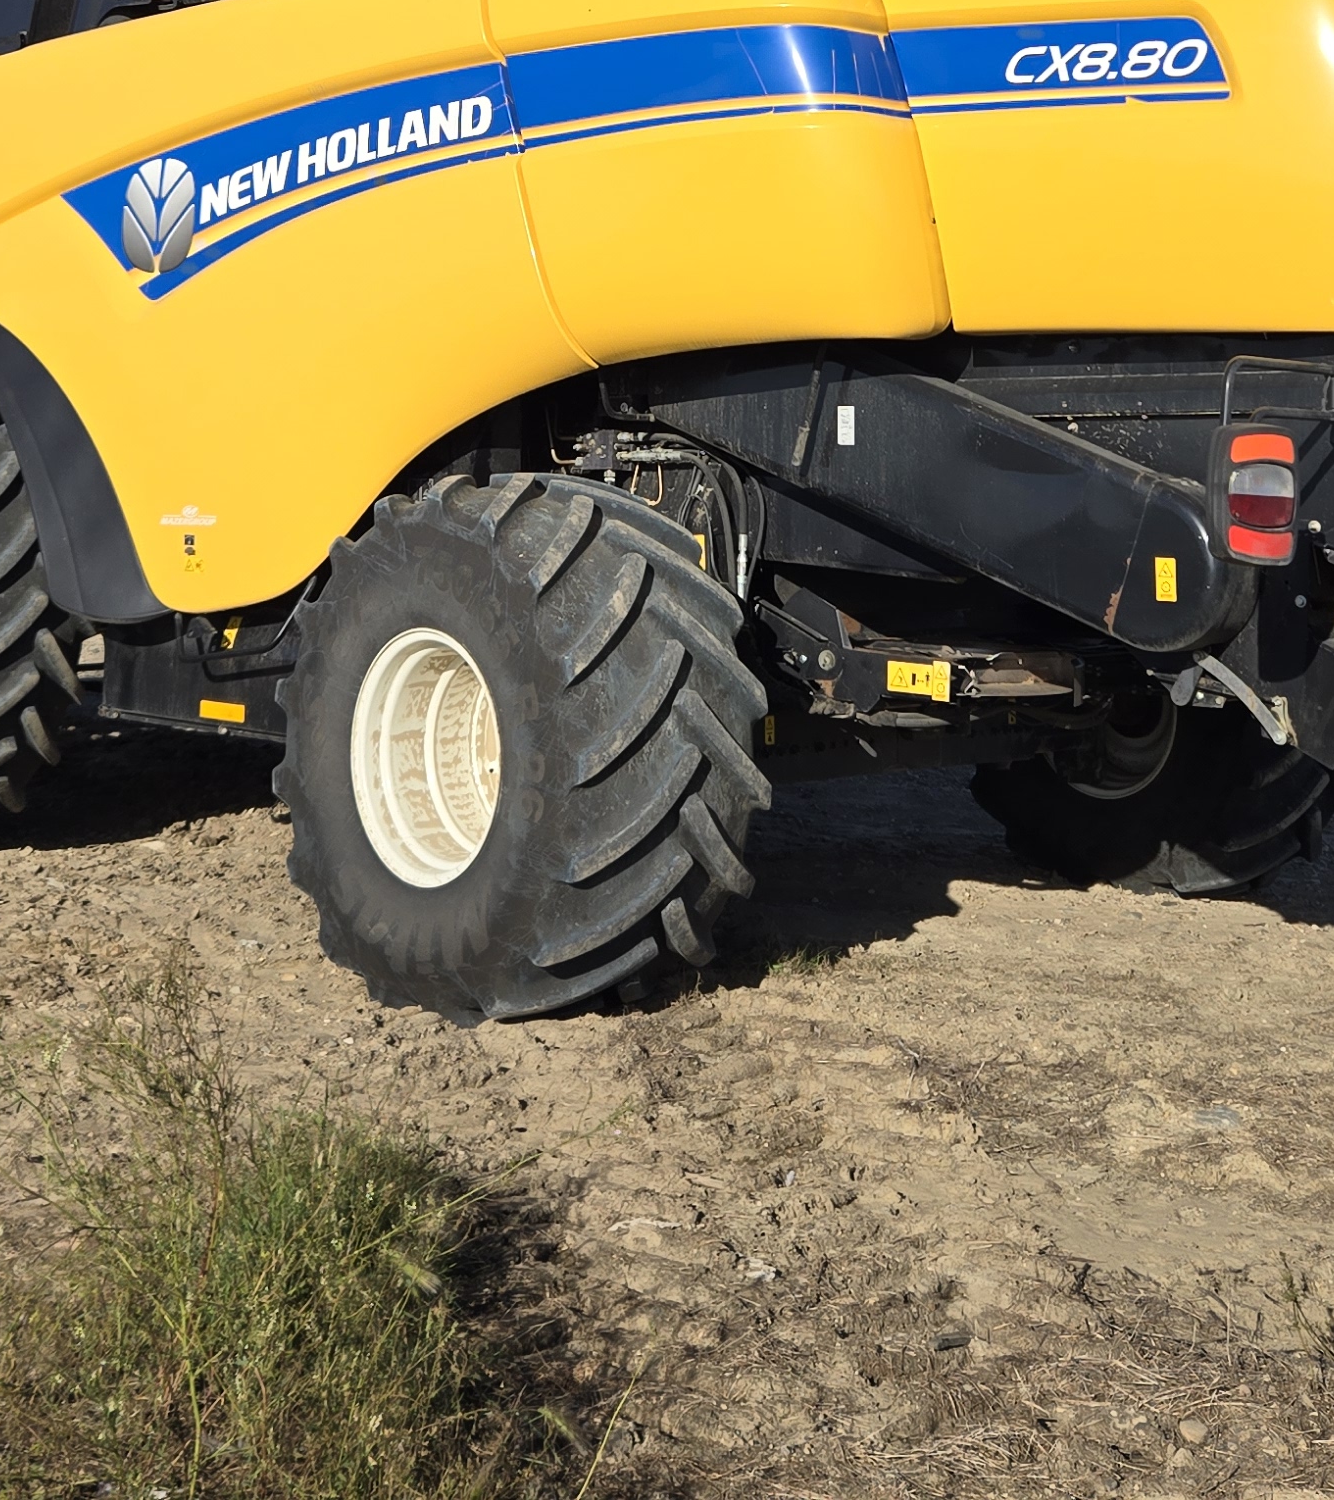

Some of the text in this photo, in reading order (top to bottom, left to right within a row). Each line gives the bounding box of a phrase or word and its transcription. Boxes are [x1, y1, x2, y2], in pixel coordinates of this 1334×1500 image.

[1005, 38, 1207, 84] CX8.80
[199, 94, 493, 224] NEW HOLLAND
